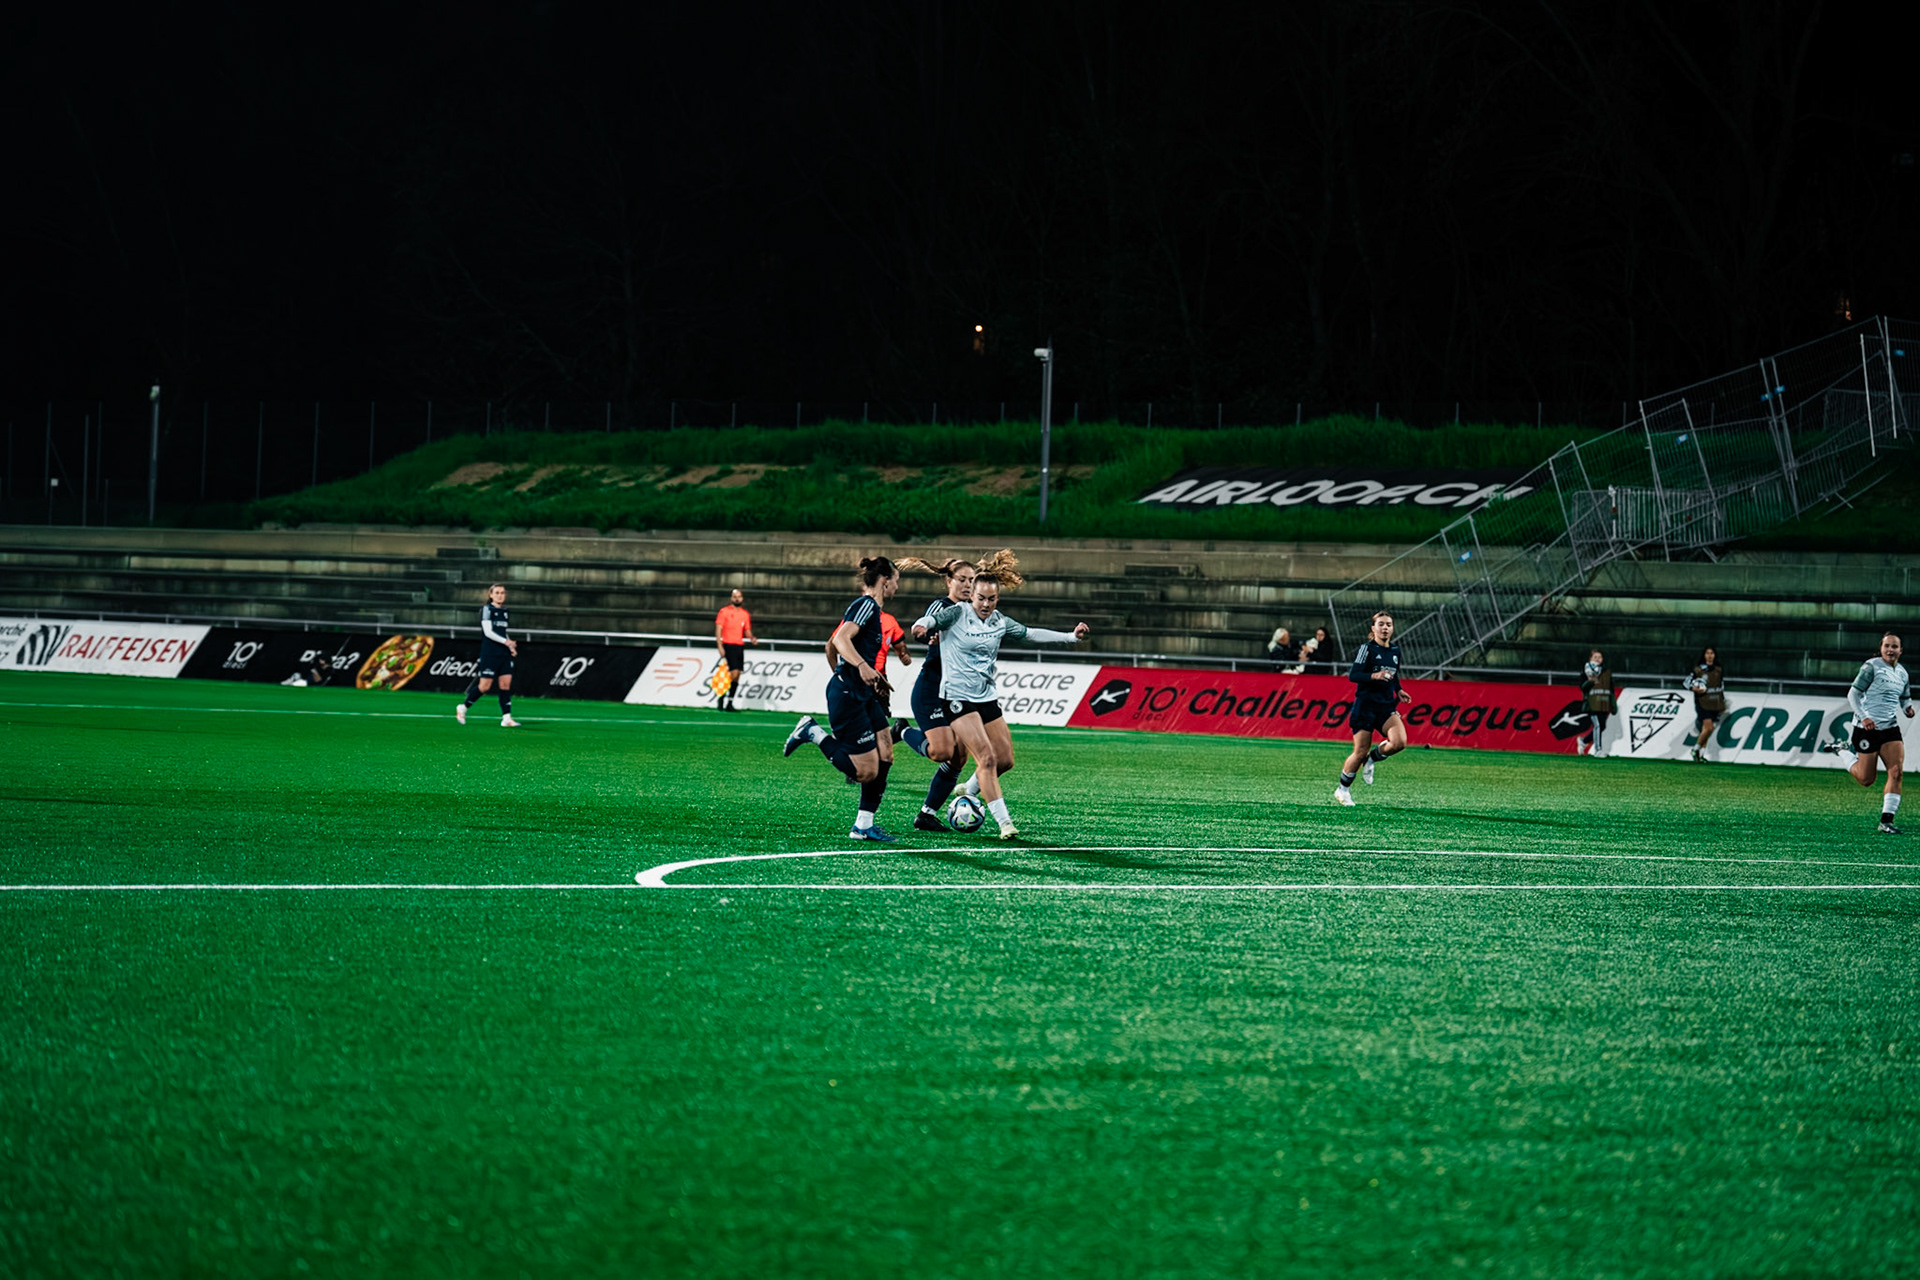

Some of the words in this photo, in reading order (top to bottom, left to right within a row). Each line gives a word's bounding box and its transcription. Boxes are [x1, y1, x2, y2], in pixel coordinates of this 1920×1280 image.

[58, 634, 196, 664] RAIFFEISEN
[429, 656, 481, 677] dieci.
[550, 677, 577, 687] dieci
[994, 671, 1075, 691] rocare
[1189, 688, 1354, 729] Challeng
[1406, 703, 1540, 736] eague
[1631, 702, 1681, 716] SCRASA
[1683, 706, 1858, 753] CRAS
